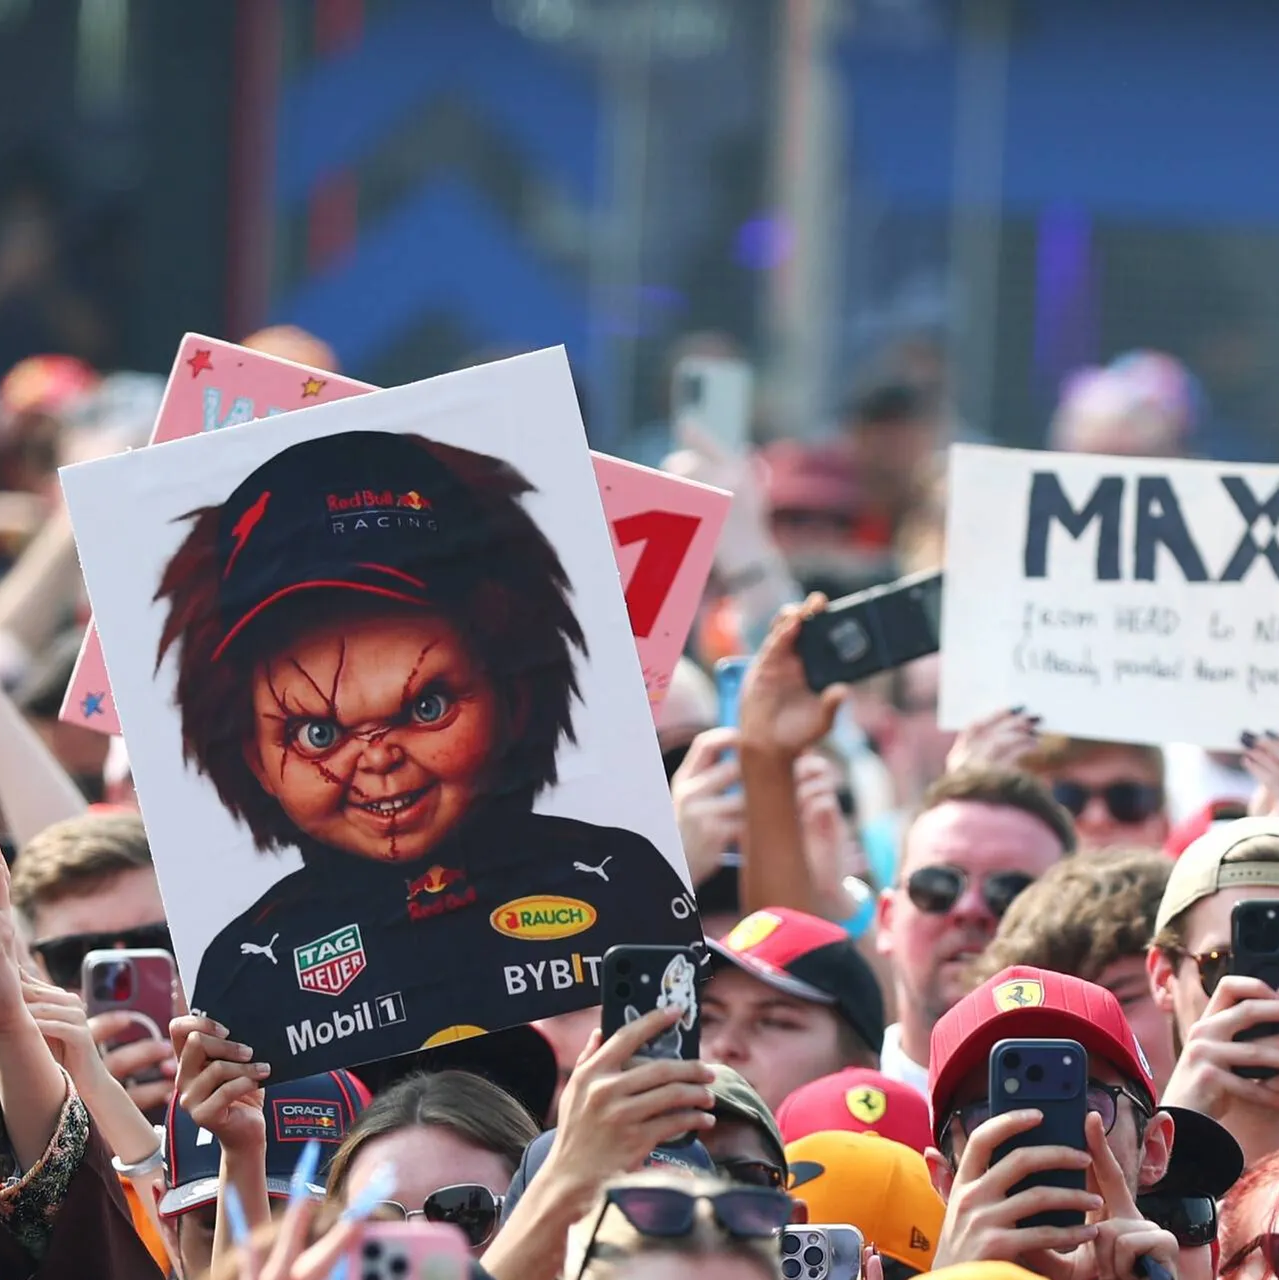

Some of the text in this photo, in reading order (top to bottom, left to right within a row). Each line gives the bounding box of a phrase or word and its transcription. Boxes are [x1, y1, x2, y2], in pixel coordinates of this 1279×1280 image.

[332, 516, 438, 534] RACING
[520, 909, 582, 927] RAUCH
[300, 932, 356, 965] TAG
[302, 955, 362, 990] HEUER
[503, 953, 603, 995] BYBIT
[286, 997, 397, 1055] Mobil 1
[282, 1105, 336, 1117] ORACLE
[285, 1128, 338, 1137] RACING
